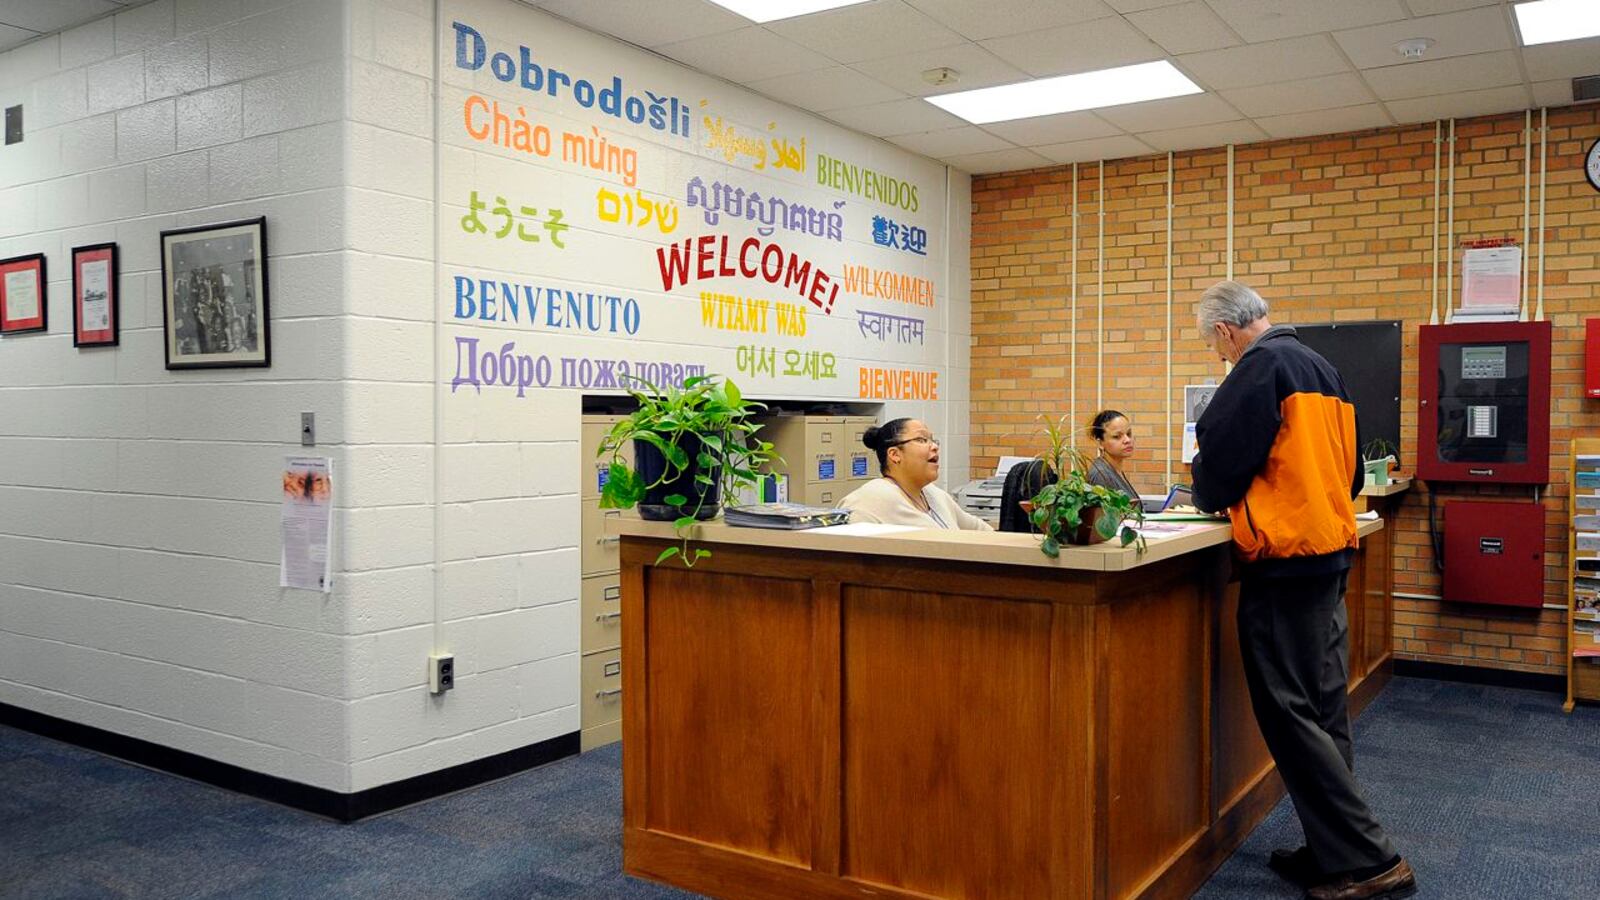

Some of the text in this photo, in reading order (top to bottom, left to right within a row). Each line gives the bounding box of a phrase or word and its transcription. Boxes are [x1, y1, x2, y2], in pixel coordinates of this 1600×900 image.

[452, 21, 690, 137] Dobrodošli
[464, 95, 637, 187] Chào mừng
[817, 154, 919, 213] BIENVENIDOS
[461, 191, 569, 249] ようこそ
[872, 215, 927, 256] 歡迎
[656, 235, 839, 315] WELCOME!
[843, 263, 934, 308] WILKOMMEN
[454, 276, 641, 335] BENVENUTO
[700, 291, 807, 337] WITAMY WAS
[451, 336, 552, 398] Добро
[736, 345, 837, 380] 어서 오세요
[859, 367, 939, 401] BIENVENUE
